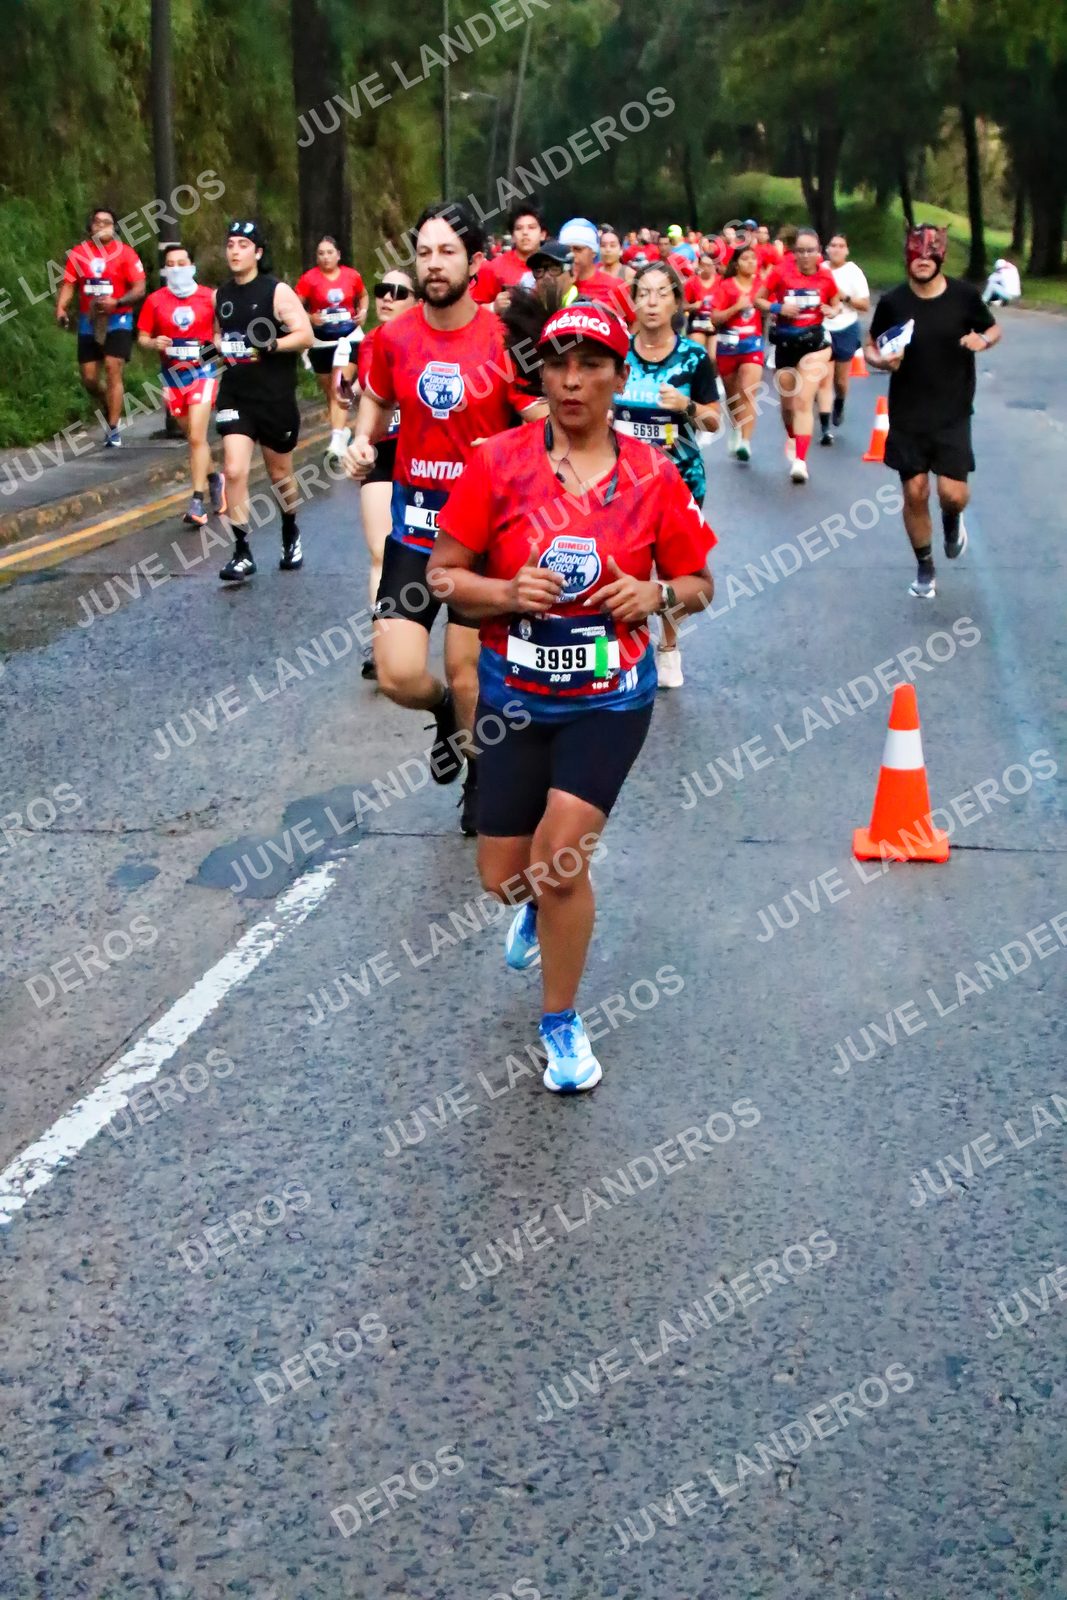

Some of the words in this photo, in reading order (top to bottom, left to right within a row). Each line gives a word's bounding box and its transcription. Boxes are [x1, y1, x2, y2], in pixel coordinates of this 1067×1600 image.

[633, 423, 660, 438] 5638
[410, 458, 467, 480] SANTIA
[557, 541, 590, 551] BIMBO
[555, 552, 589, 566] Global
[548, 561, 574, 573] Race
[535, 647, 587, 670] 3999
